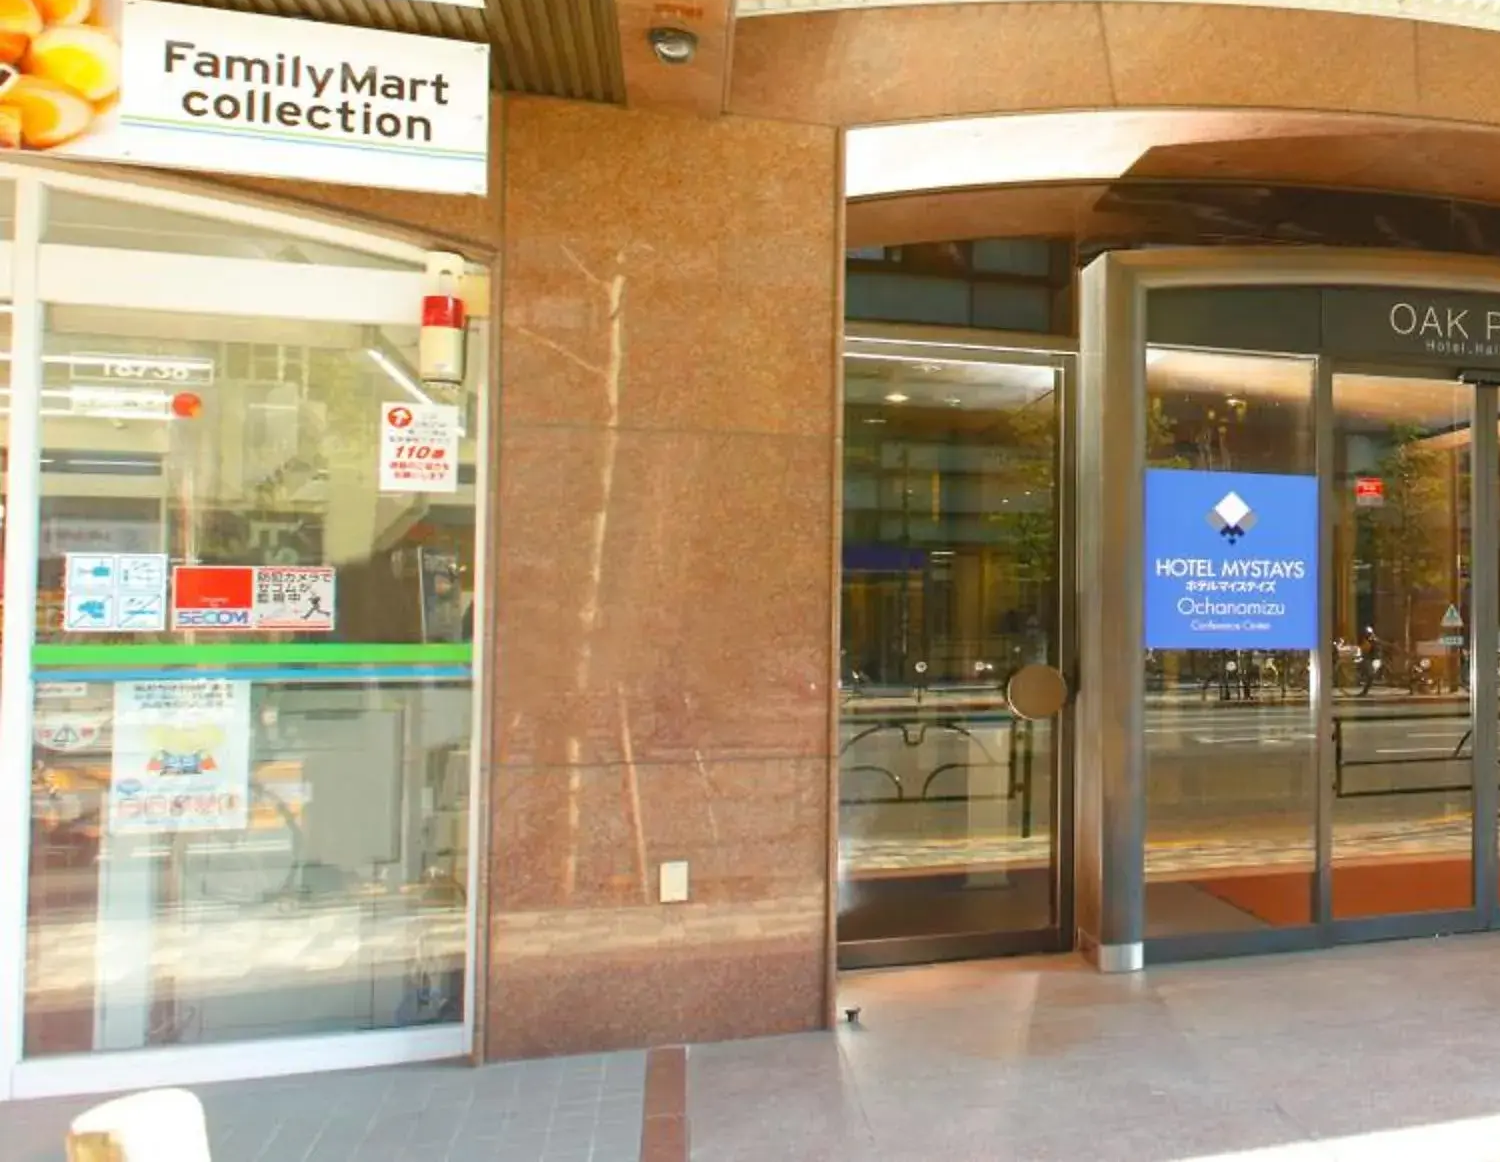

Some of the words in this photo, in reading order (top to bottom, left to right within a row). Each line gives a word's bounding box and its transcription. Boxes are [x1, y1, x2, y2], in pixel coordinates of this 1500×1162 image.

[164, 40, 450, 105] FamilyMart
[182, 89, 433, 142] collection
[1389, 302, 1469, 339] OAK
[1155, 557, 1216, 577] HOTEL
[1220, 558, 1305, 579] MYSTAYS
[177, 610, 250, 626] SECOM
[1176, 596, 1286, 616] Ochanomizu
